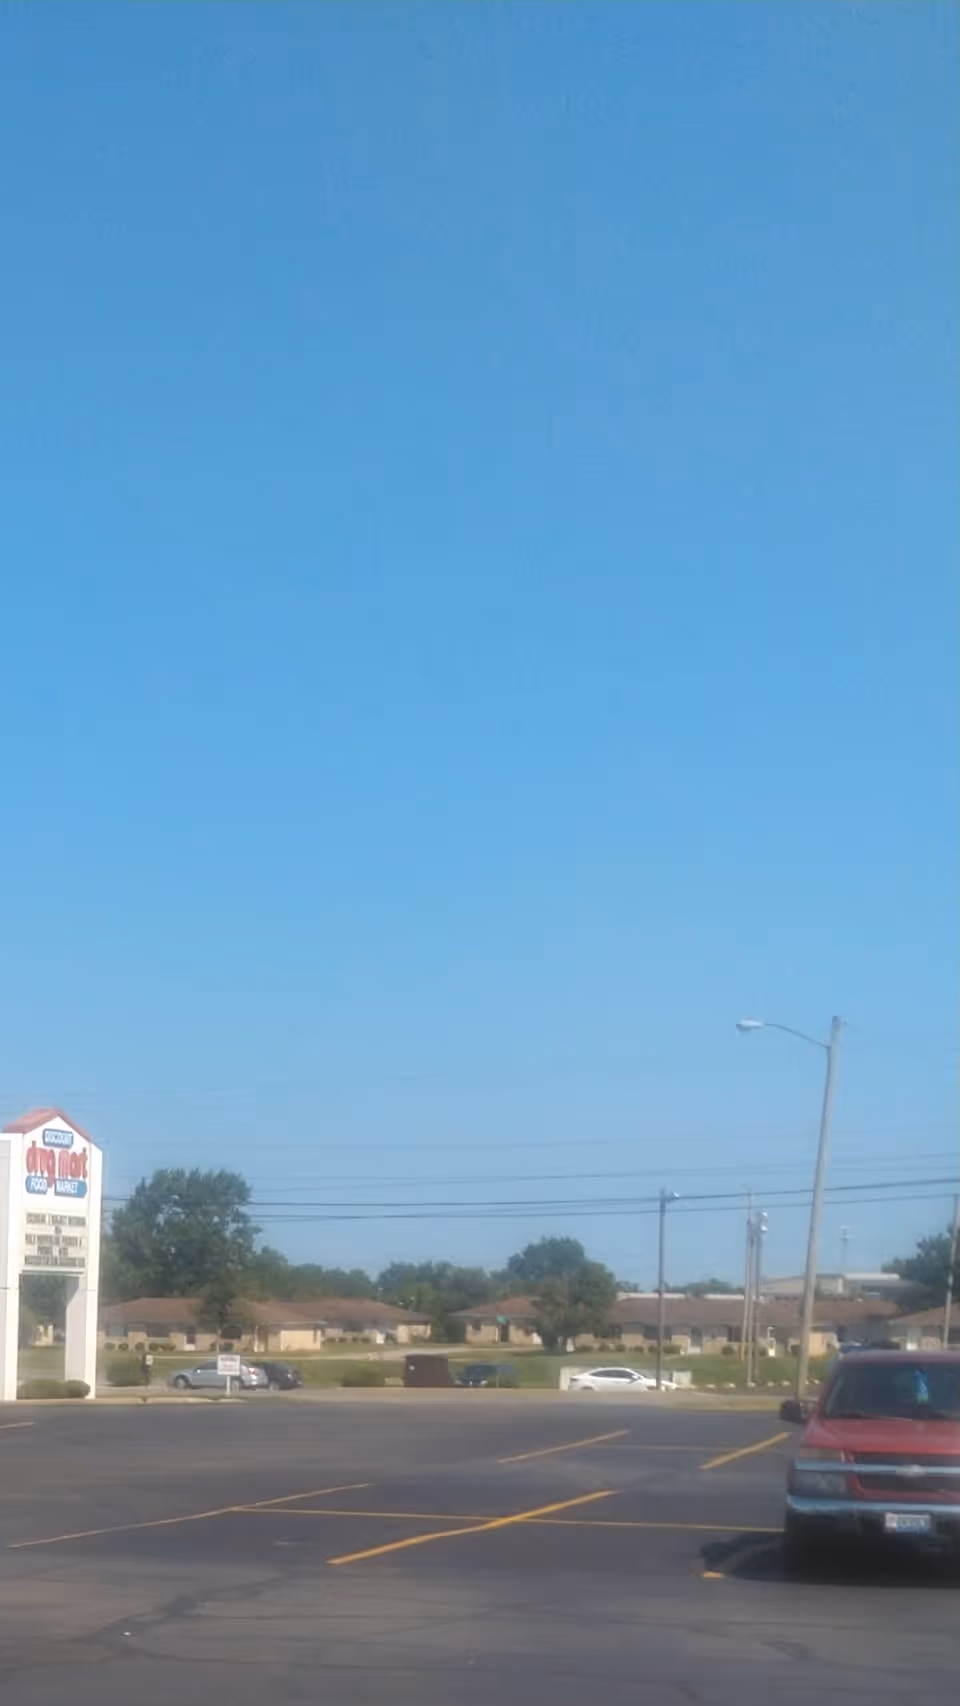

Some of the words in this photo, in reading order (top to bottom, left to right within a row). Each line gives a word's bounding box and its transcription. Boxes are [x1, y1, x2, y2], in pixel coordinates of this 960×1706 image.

[26, 1140, 56, 1189] drug
[58, 1147, 88, 1180] mart
[30, 1178, 47, 1191] FOOD
[56, 1179, 78, 1193] MARKET
